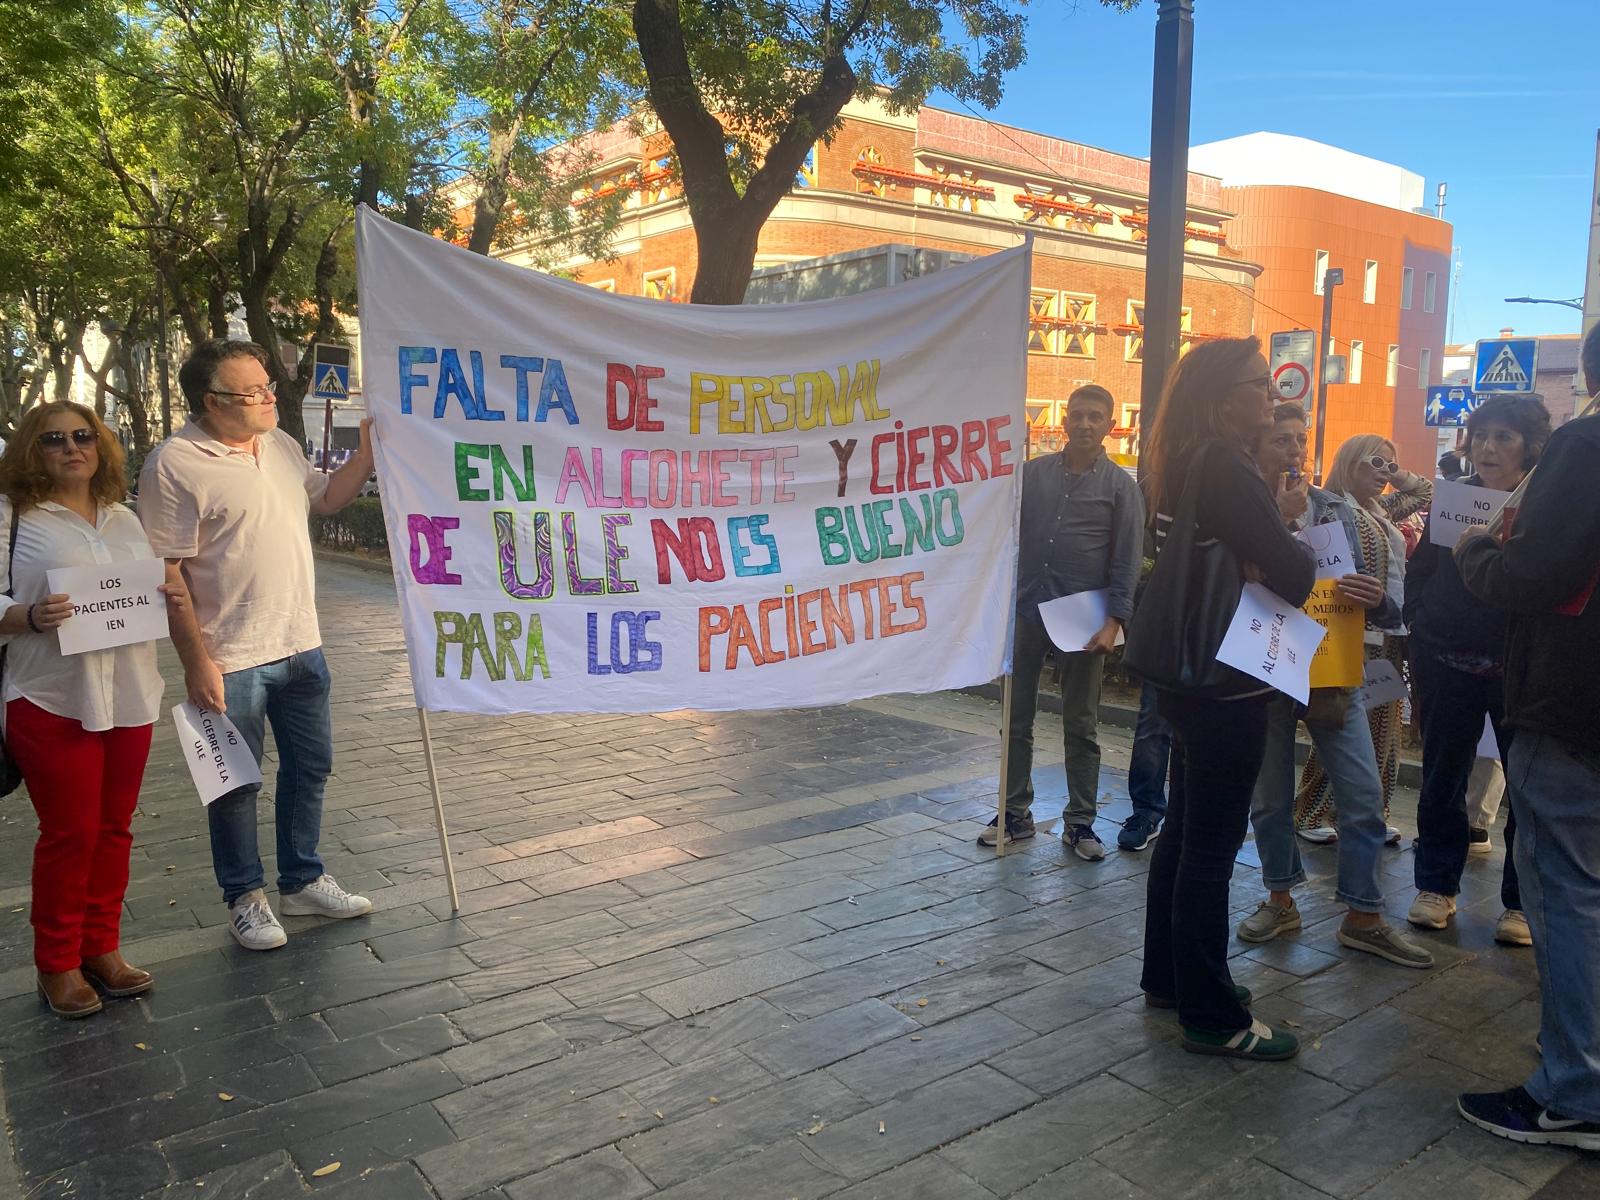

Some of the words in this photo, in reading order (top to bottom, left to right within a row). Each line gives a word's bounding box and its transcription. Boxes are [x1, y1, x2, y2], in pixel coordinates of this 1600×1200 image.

[397, 345, 579, 426] FALTA
[606, 362, 666, 432] DE
[689, 358, 891, 435] PERSONAL
[453, 441, 536, 502] EN
[555, 445, 799, 509] ALCOHETE
[828, 438, 857, 498] Y
[1473, 500, 1491, 512] NO
[1439, 510, 1452, 521] AL
[407, 513, 462, 586] DE
[491, 509, 639, 600] ULE
[649, 516, 726, 586] NO
[728, 513, 782, 579] ES
[814, 488, 965, 567] BUENO
[1326, 554, 1343, 566] LA
[100, 578, 121, 590] LOS
[74, 596, 134, 616] PACIENTES
[136, 594, 150, 606] AL
[1313, 603, 1355, 615] MEDIOS
[106, 618, 125, 631] IEN
[1250, 618, 1262, 634] NO
[433, 610, 552, 682] PARA
[586, 610, 662, 676] LOS
[1262, 660, 1276, 675] AL
[1275, 612, 1287, 627] LA
[202, 718, 220, 754] CIERRE
[226, 730, 238, 746] NO
[194, 739, 207, 761] ULE
[214, 754, 225, 769] DE
[219, 769, 229, 784] LA
